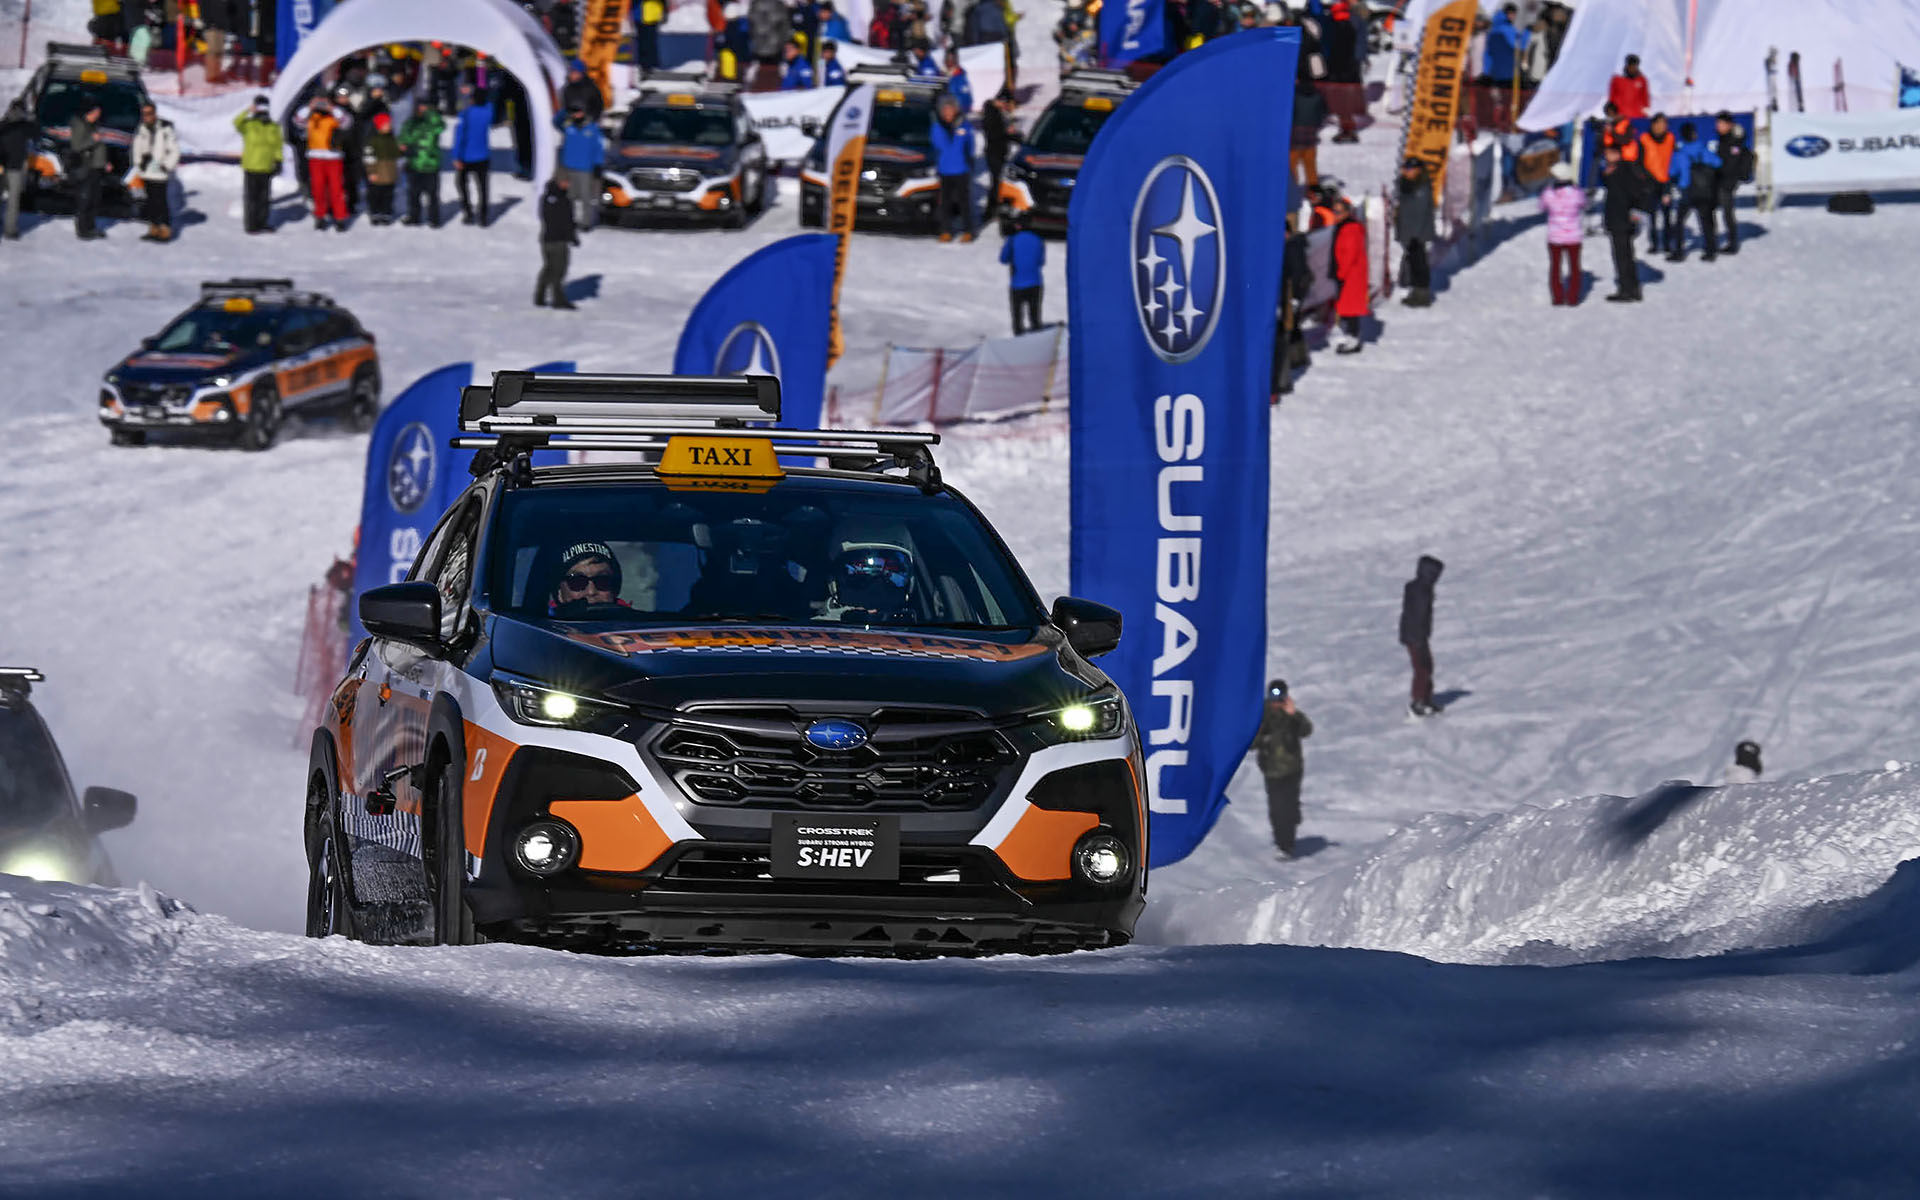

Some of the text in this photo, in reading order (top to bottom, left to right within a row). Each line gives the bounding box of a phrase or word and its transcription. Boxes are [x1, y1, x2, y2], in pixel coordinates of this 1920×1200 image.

[1427, 16, 1467, 133] GELANDE
[688, 446, 753, 466] TAXI
[1147, 393, 1205, 814] SUBARU
[797, 827, 874, 836] CROSSTREK
[797, 847, 872, 868] S:HEV
